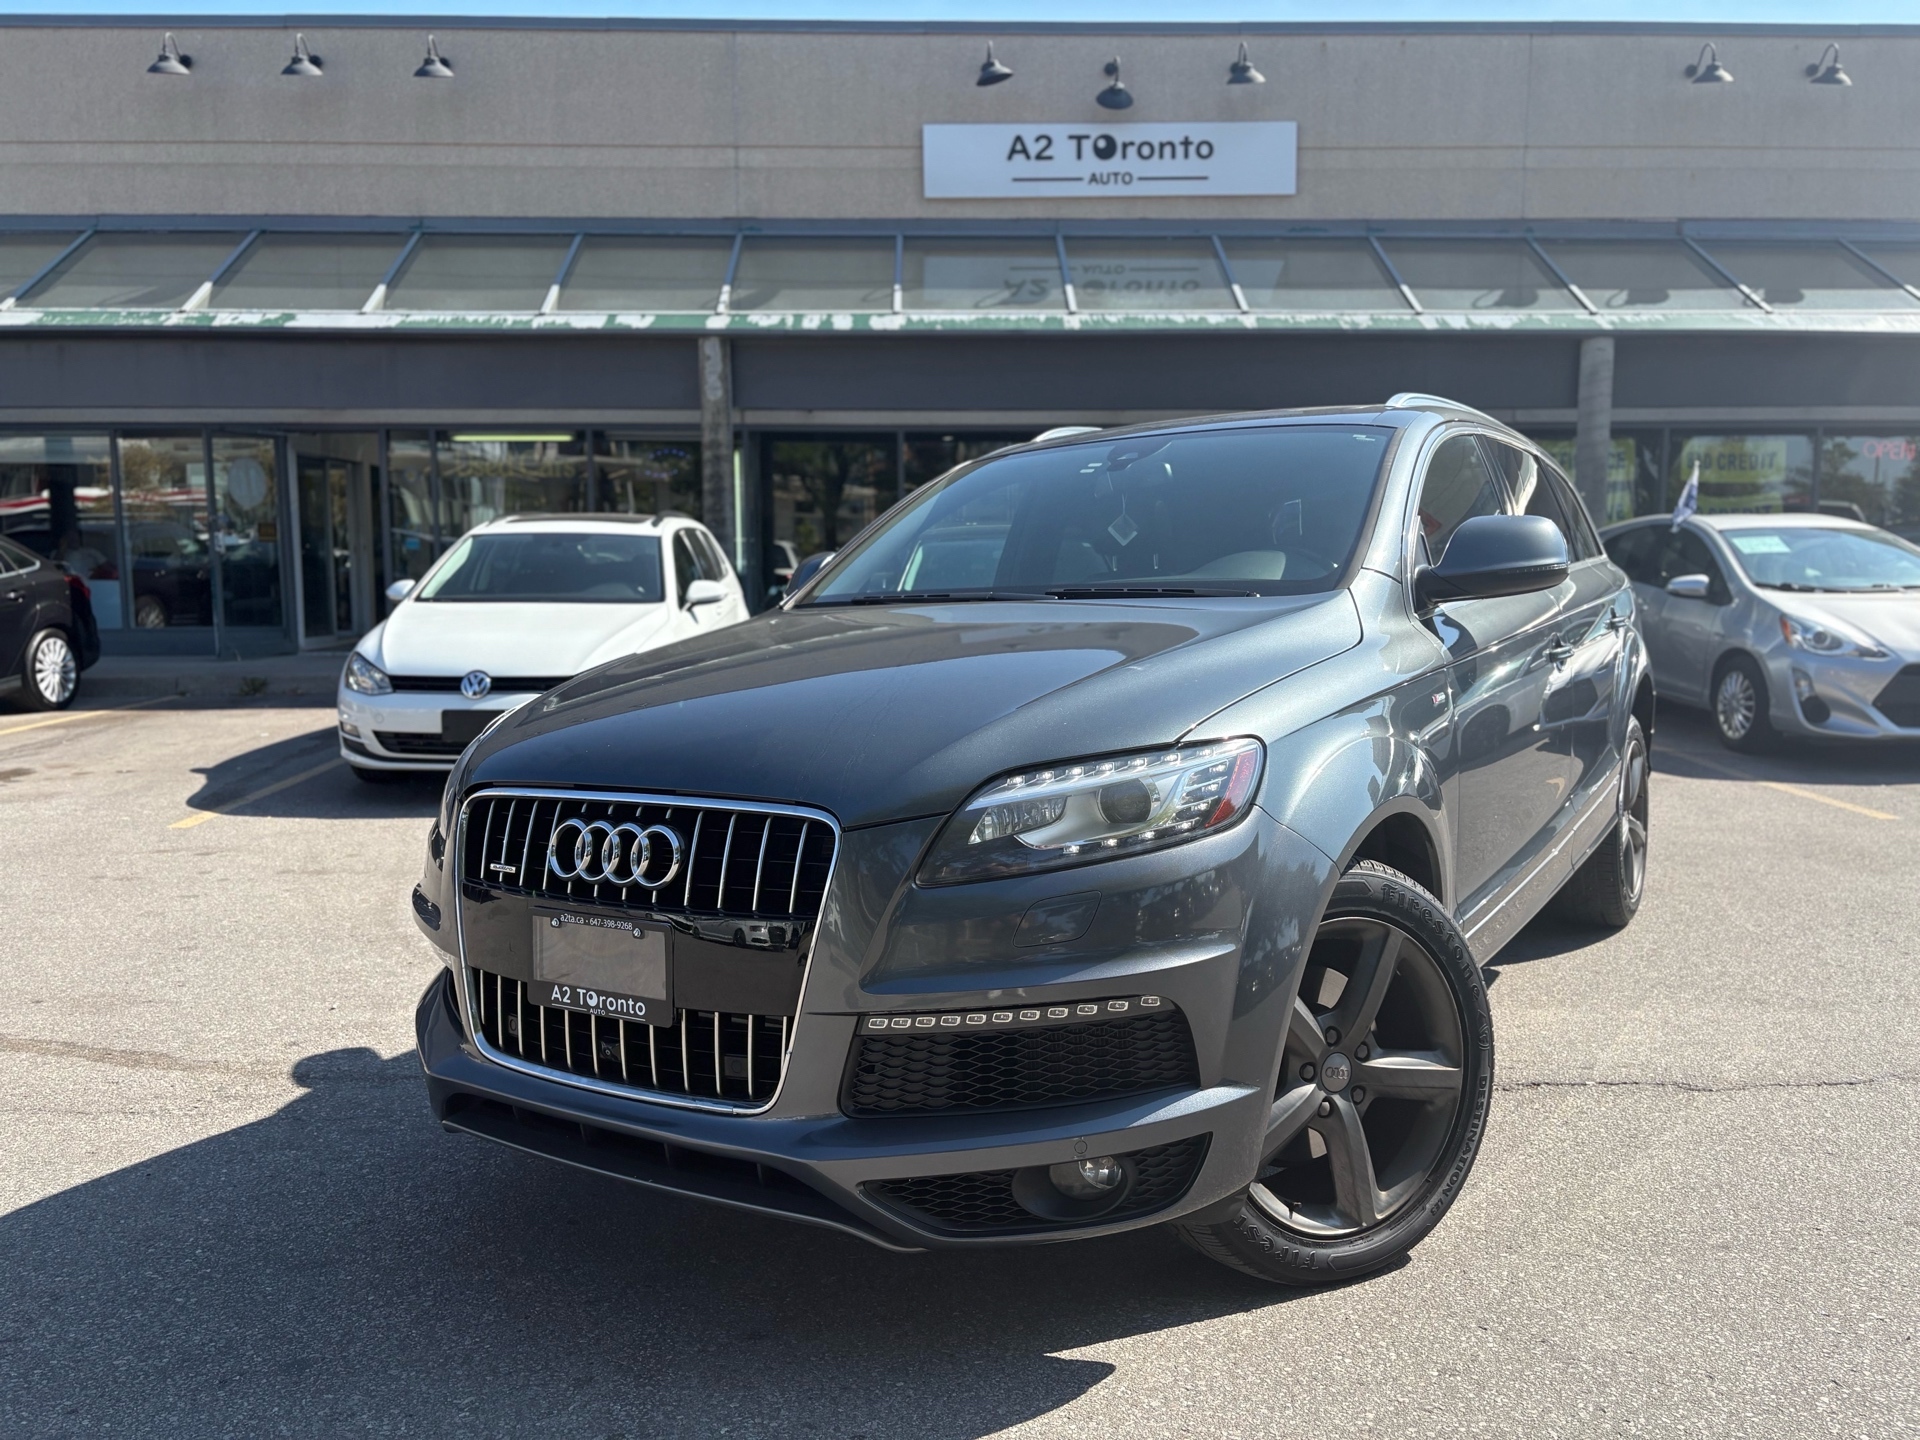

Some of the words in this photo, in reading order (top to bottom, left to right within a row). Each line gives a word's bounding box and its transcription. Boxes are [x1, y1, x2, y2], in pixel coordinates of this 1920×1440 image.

[1006, 134, 1055, 162] A2
[1087, 172, 1134, 186] AUTO
[1863, 440, 1917, 461] OPEN
[1716, 451, 1779, 471] CREDIT
[560, 913, 584, 925] a2ta.ca
[589, 917, 633, 931] 647-398-9268
[551, 984, 571, 1004] A2
[589, 1008, 606, 1016] AUTO
[1441, 1074, 1488, 1198] DESTINATION
